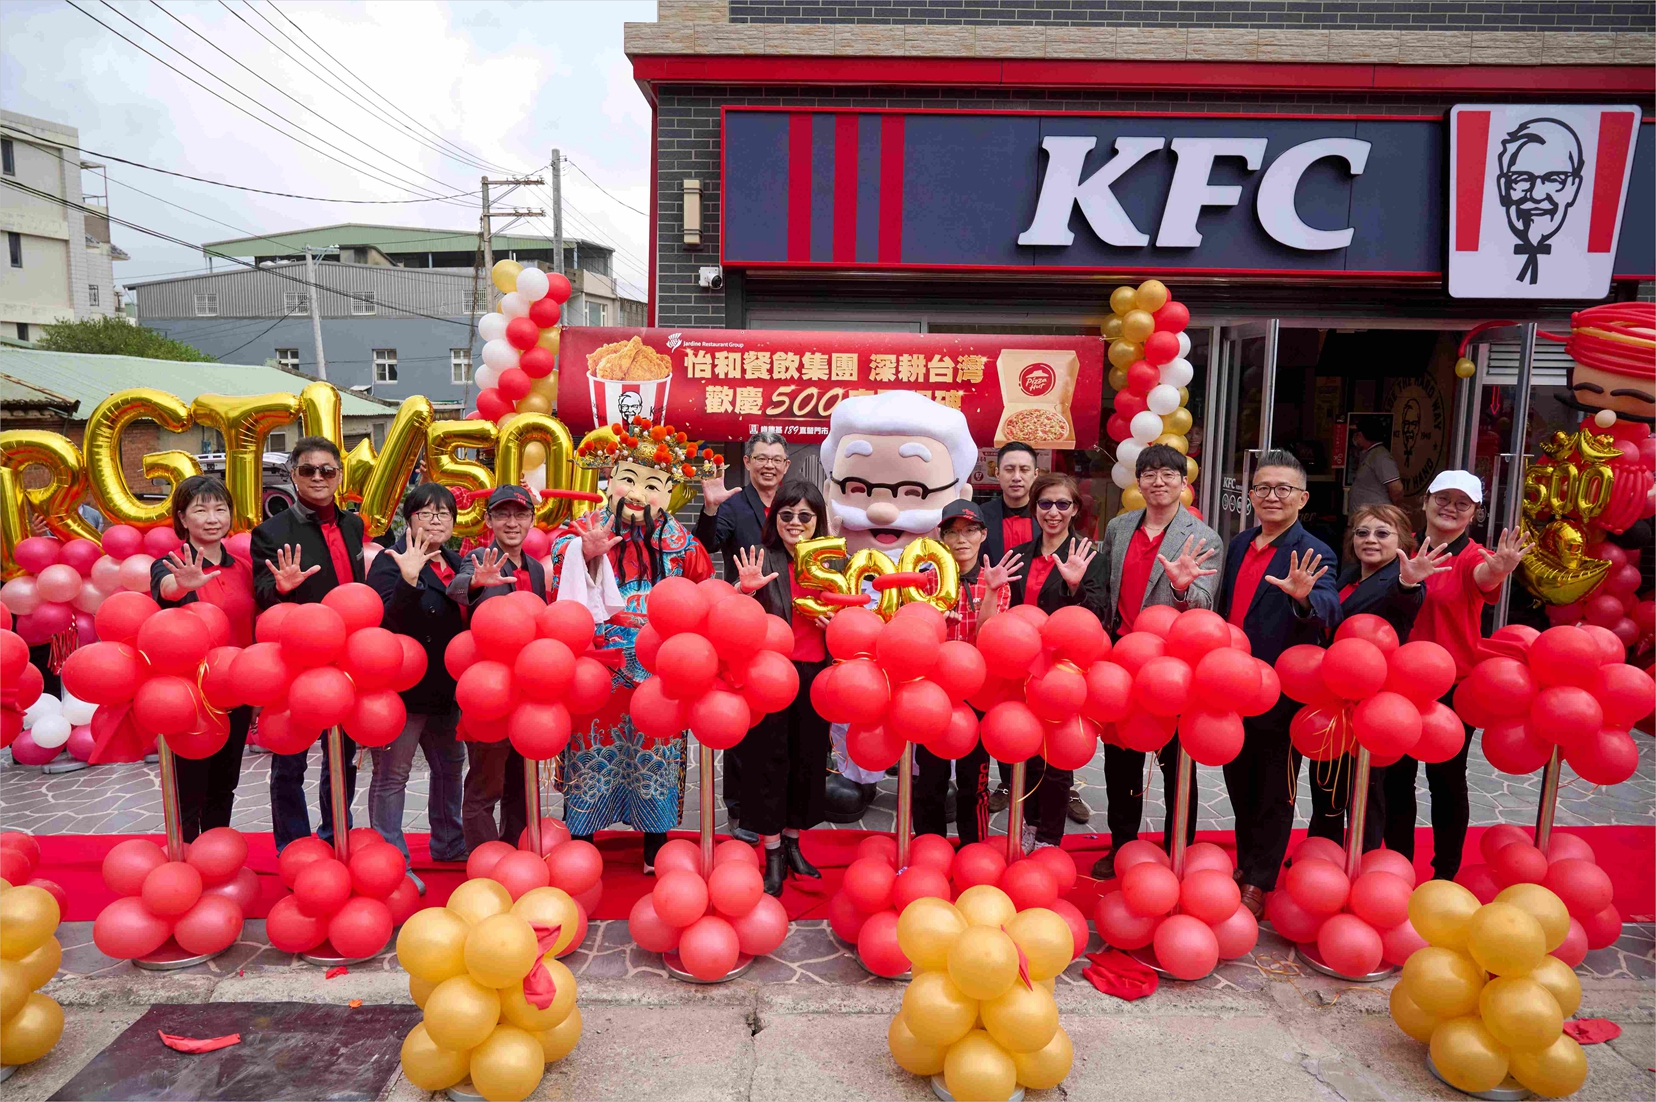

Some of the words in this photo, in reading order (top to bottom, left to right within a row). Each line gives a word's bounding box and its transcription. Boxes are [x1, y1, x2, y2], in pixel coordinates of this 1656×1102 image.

[1017, 135, 1373, 251] KFC
[684, 350, 859, 382] 怡和餐飲集團
[869, 353, 985, 384] 深耕台灣
[1026, 377, 1047, 387] Pizza
[1029, 383, 1046, 391] Hut
[1222, 476, 1236, 489] KFC
[1523, 462, 1615, 521] 500
[793, 535, 960, 623] 500
